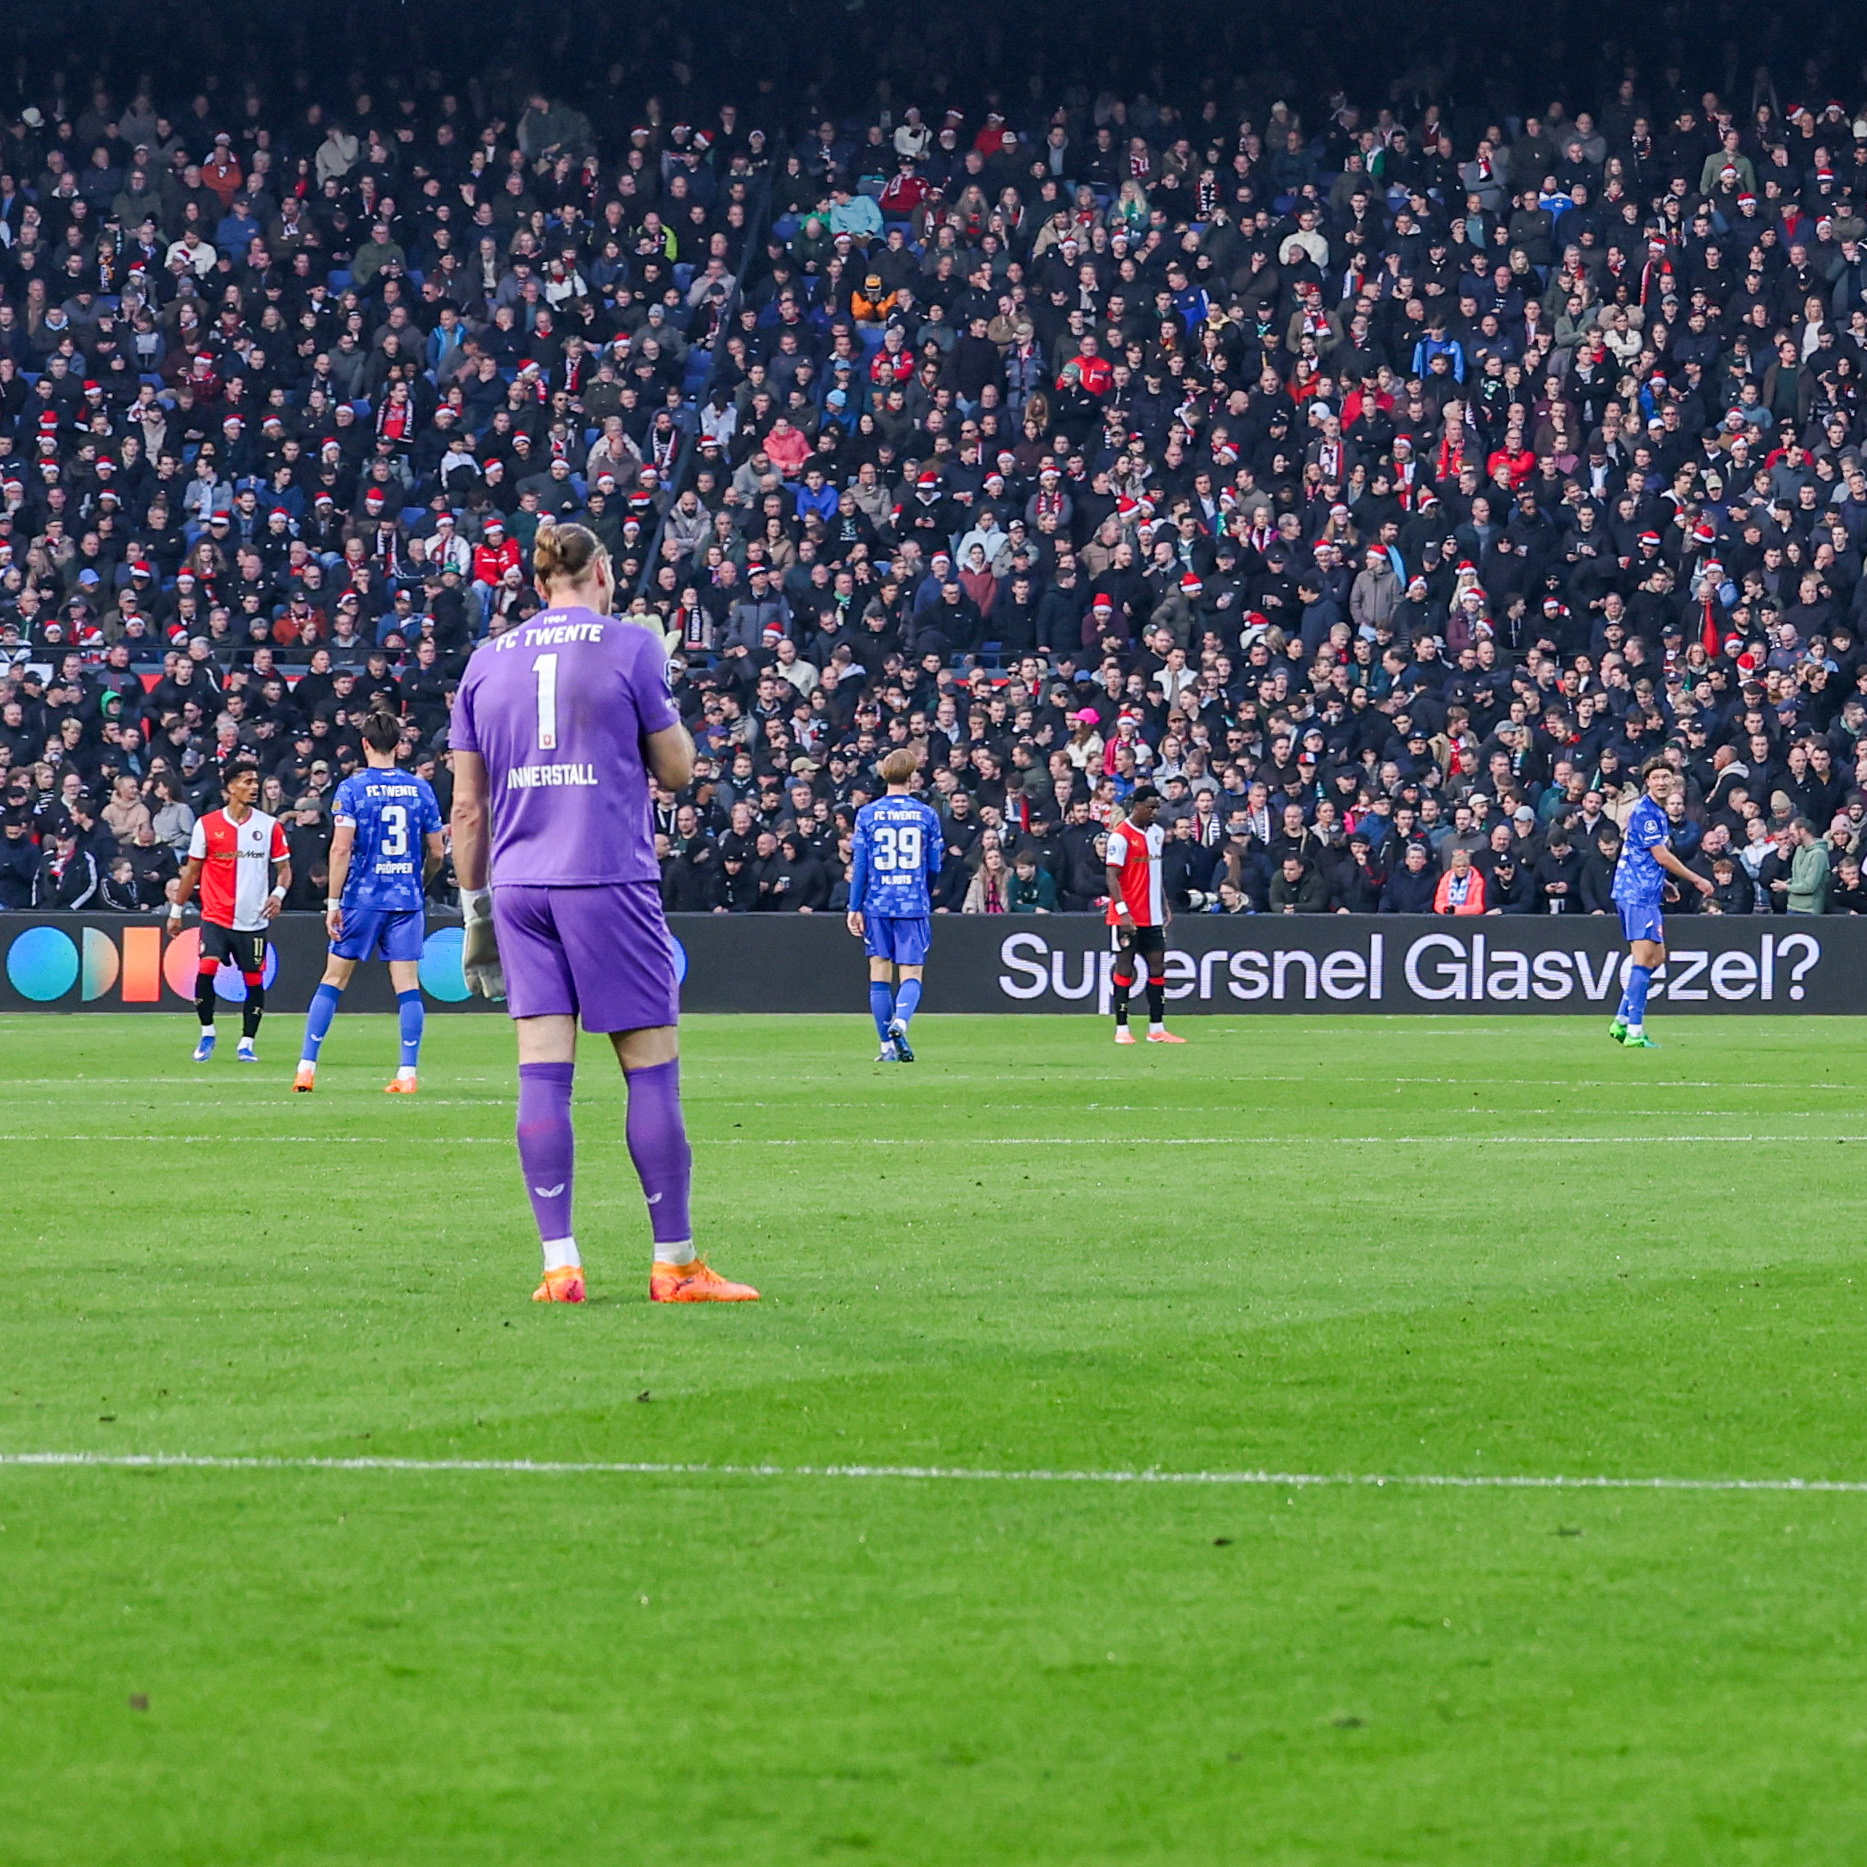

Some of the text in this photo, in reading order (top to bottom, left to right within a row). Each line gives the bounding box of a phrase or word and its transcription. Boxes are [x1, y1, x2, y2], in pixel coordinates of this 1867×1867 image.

[495, 624, 603, 652] FC TWENTE
[532, 652, 558, 750] 1
[365, 784, 418, 797] FC TWENTE
[381, 805, 407, 856] 3
[874, 810, 922, 821] FC TWENTE
[874, 827, 921, 870] 39
